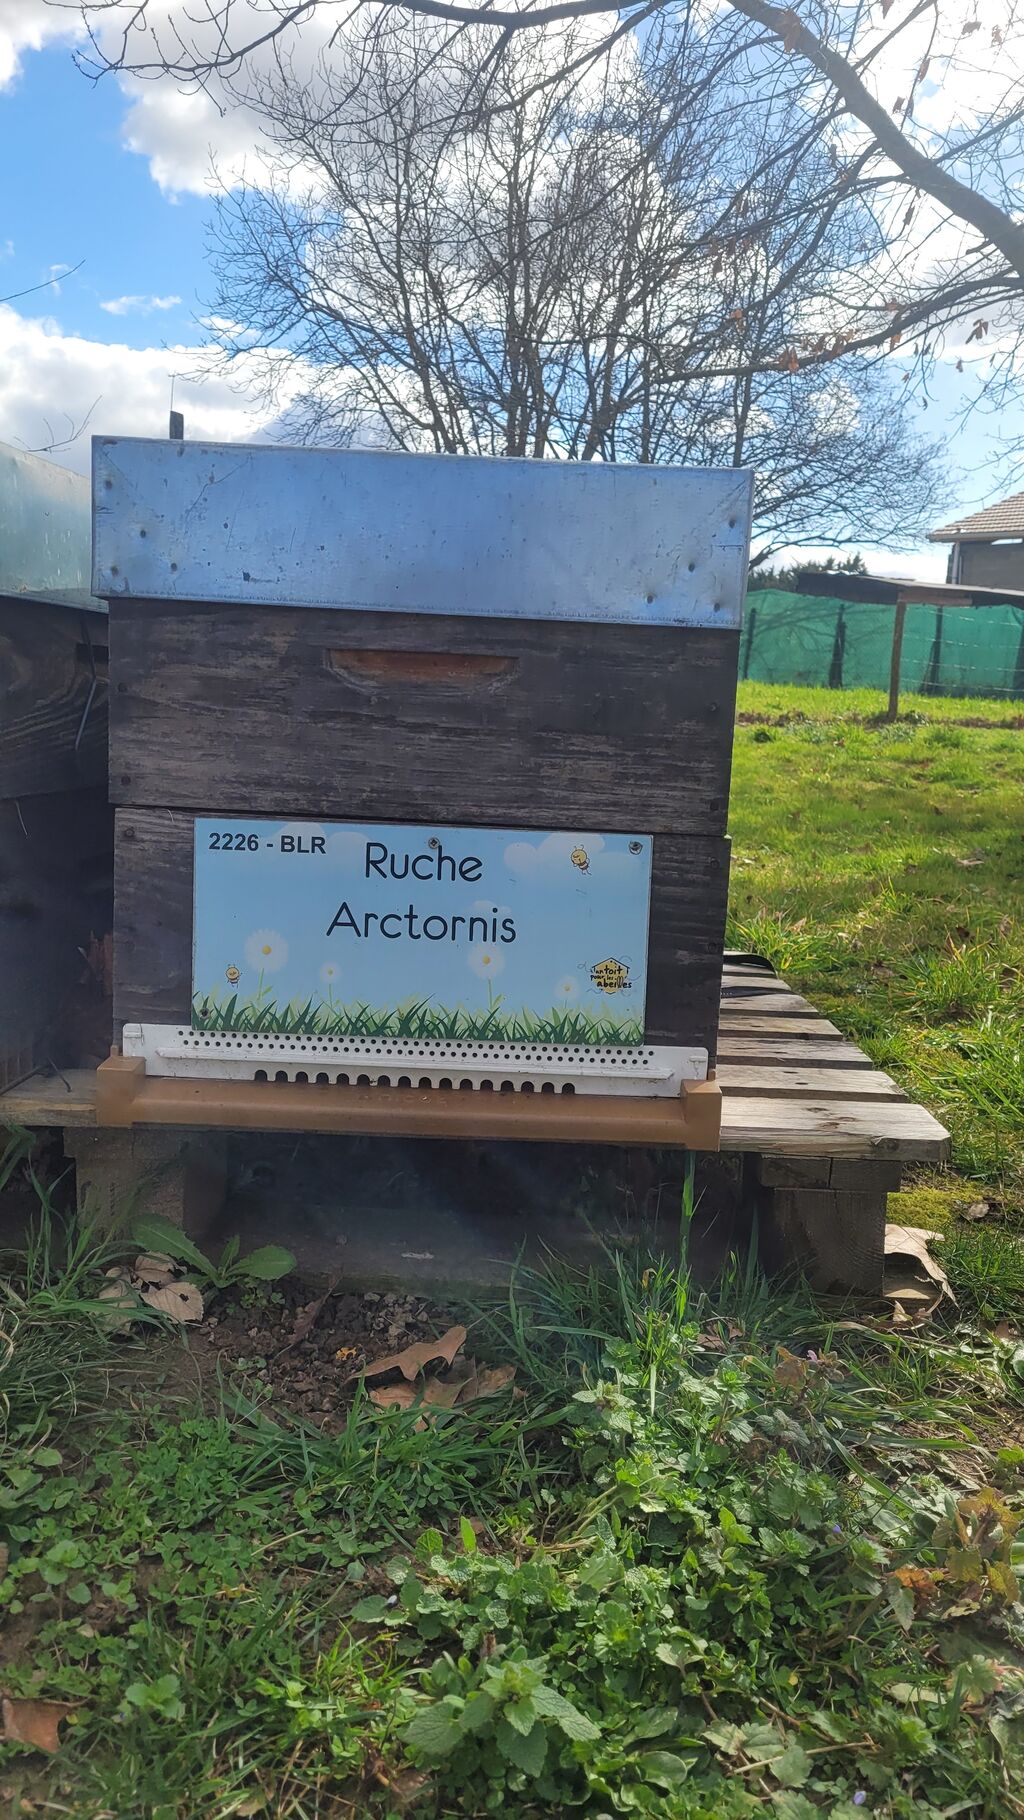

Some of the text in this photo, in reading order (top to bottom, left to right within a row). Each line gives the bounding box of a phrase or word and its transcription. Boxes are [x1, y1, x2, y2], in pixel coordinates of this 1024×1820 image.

[208, 832, 259, 852] 2226
[280, 834, 327, 855] BLR
[365, 841, 483, 882] Ruche
[325, 901, 517, 944] Arctornis
[604, 965, 623, 975] toit
[596, 976, 632, 989] abeilles
